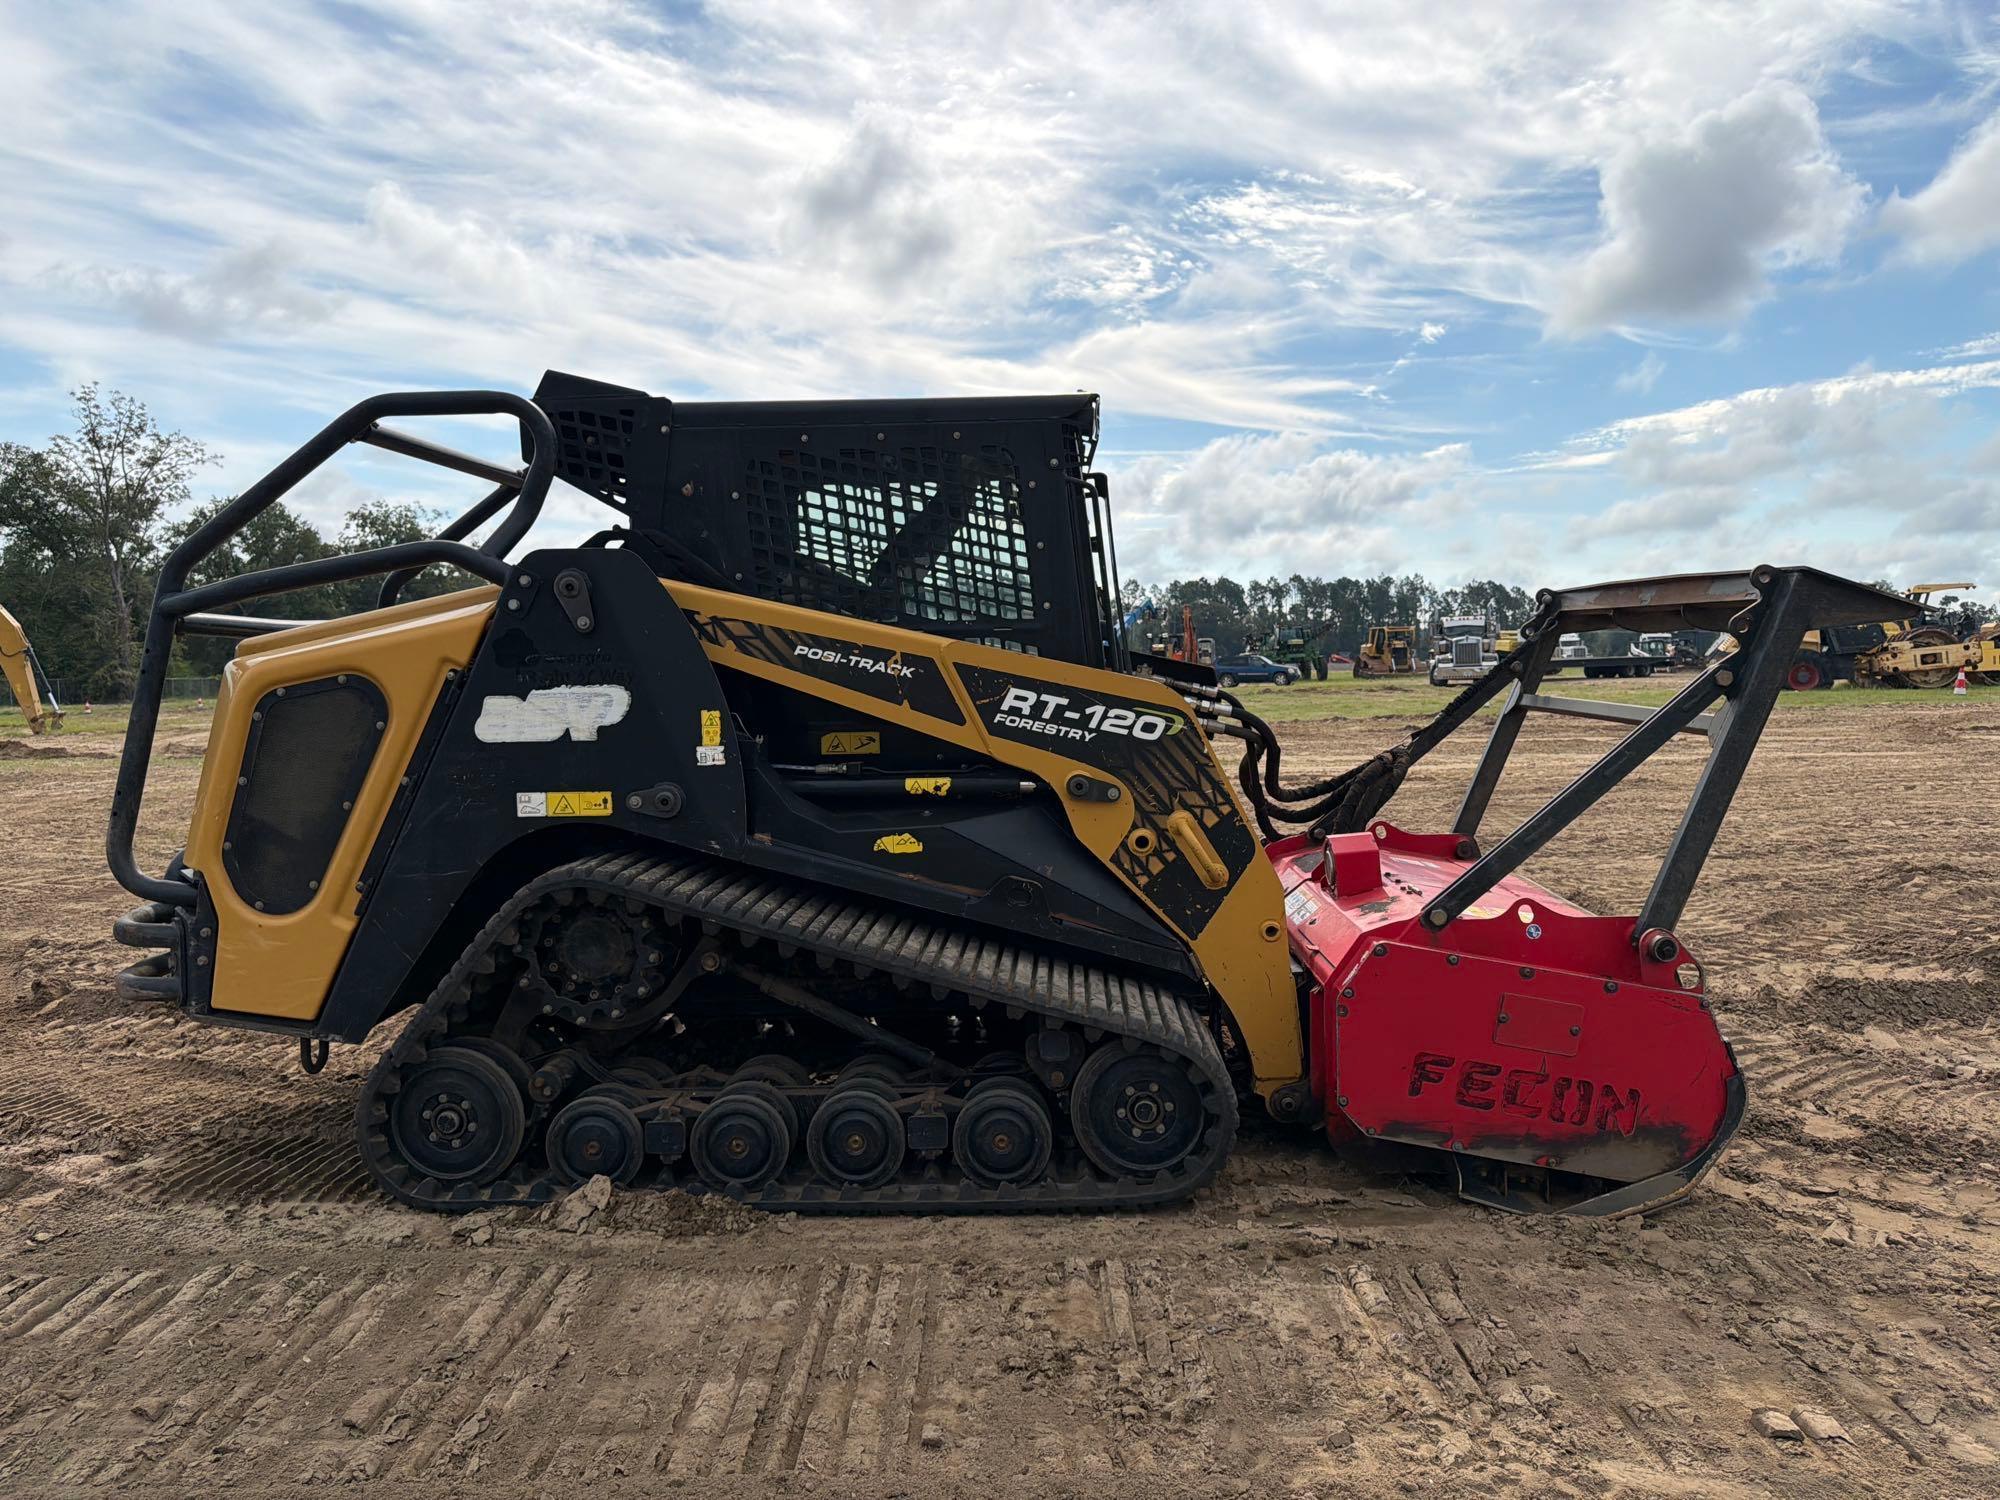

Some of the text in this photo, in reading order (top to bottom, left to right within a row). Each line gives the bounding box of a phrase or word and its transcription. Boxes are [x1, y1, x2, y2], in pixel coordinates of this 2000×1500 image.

[794, 645, 915, 678] POSI-TRACK
[993, 713, 1098, 742] FORESTRY
[1000, 687, 1166, 741] RT-120
[1407, 1052, 1642, 1137] FECON
